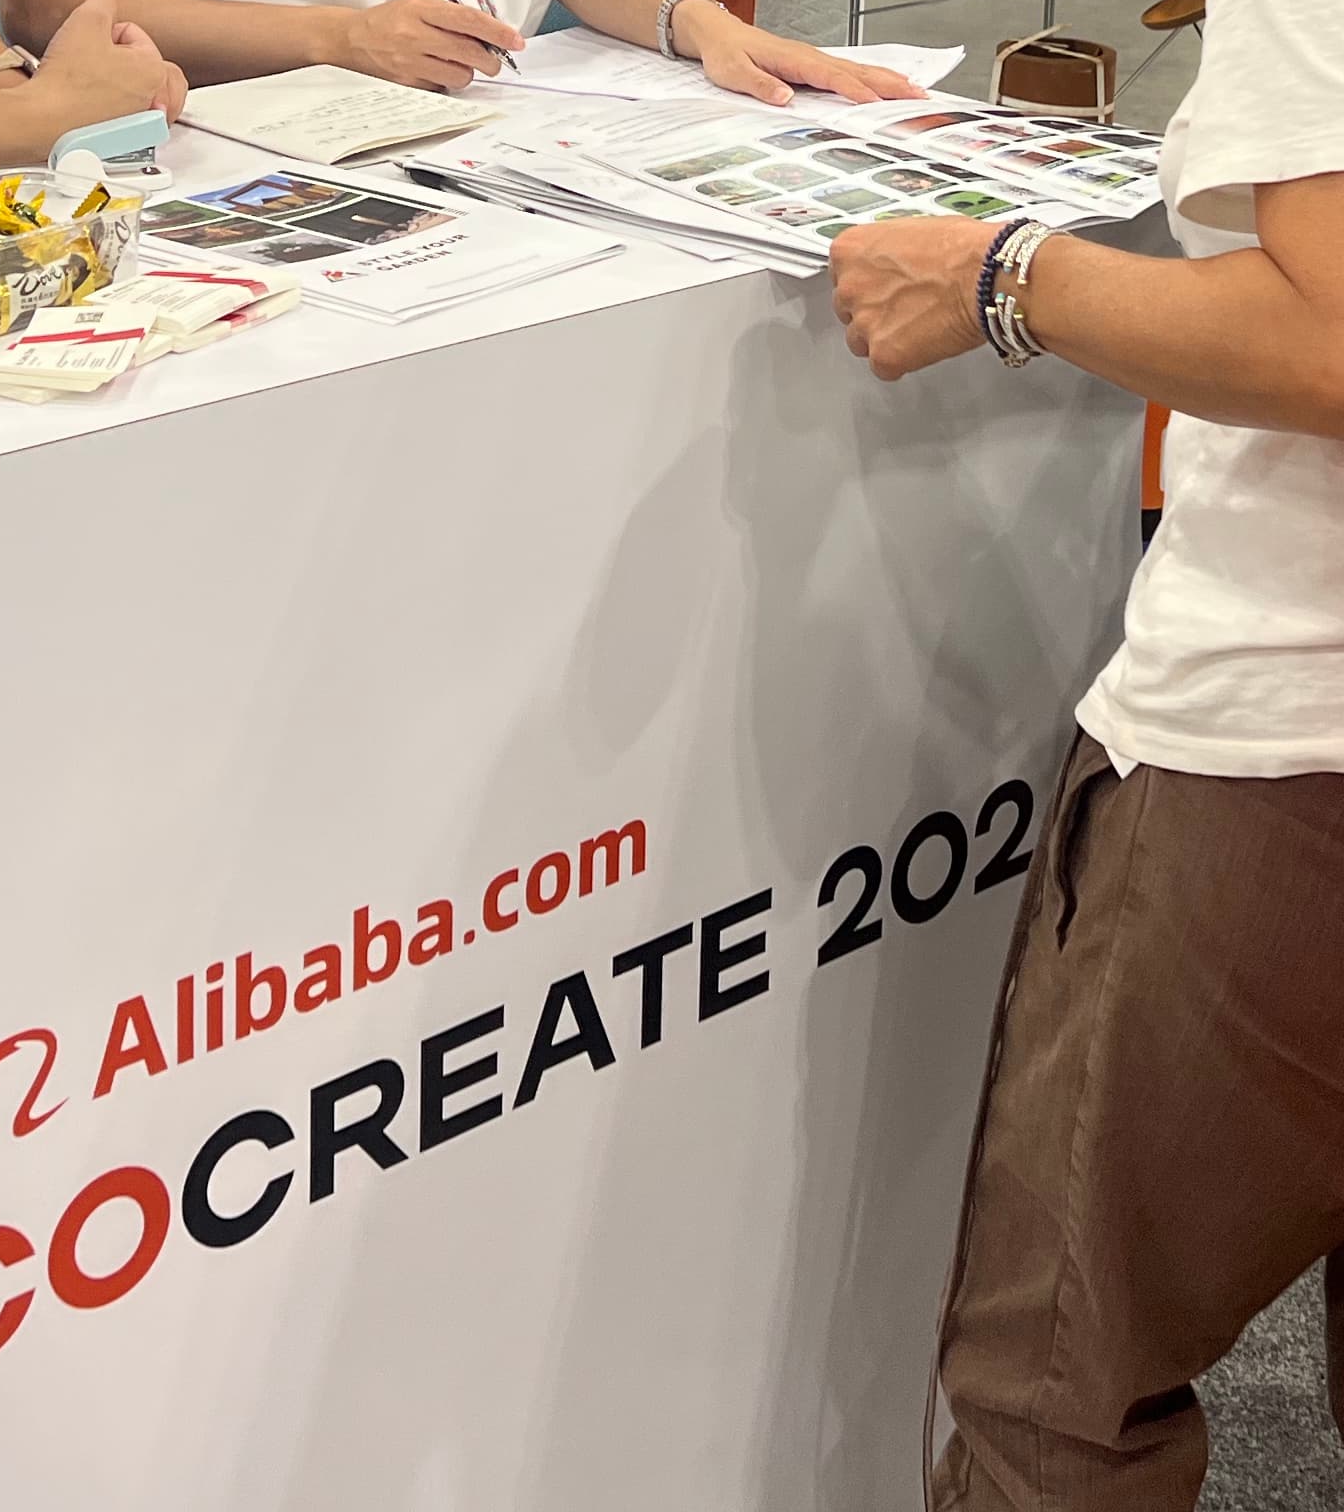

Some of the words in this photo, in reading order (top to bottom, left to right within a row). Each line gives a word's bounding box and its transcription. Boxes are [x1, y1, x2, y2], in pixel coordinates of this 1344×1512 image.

[358, 249, 417, 267] STYLE
[417, 233, 471, 252] YOUR
[376, 249, 453, 272] GARDEN
[92, 816, 650, 1100] Alibaba.com
